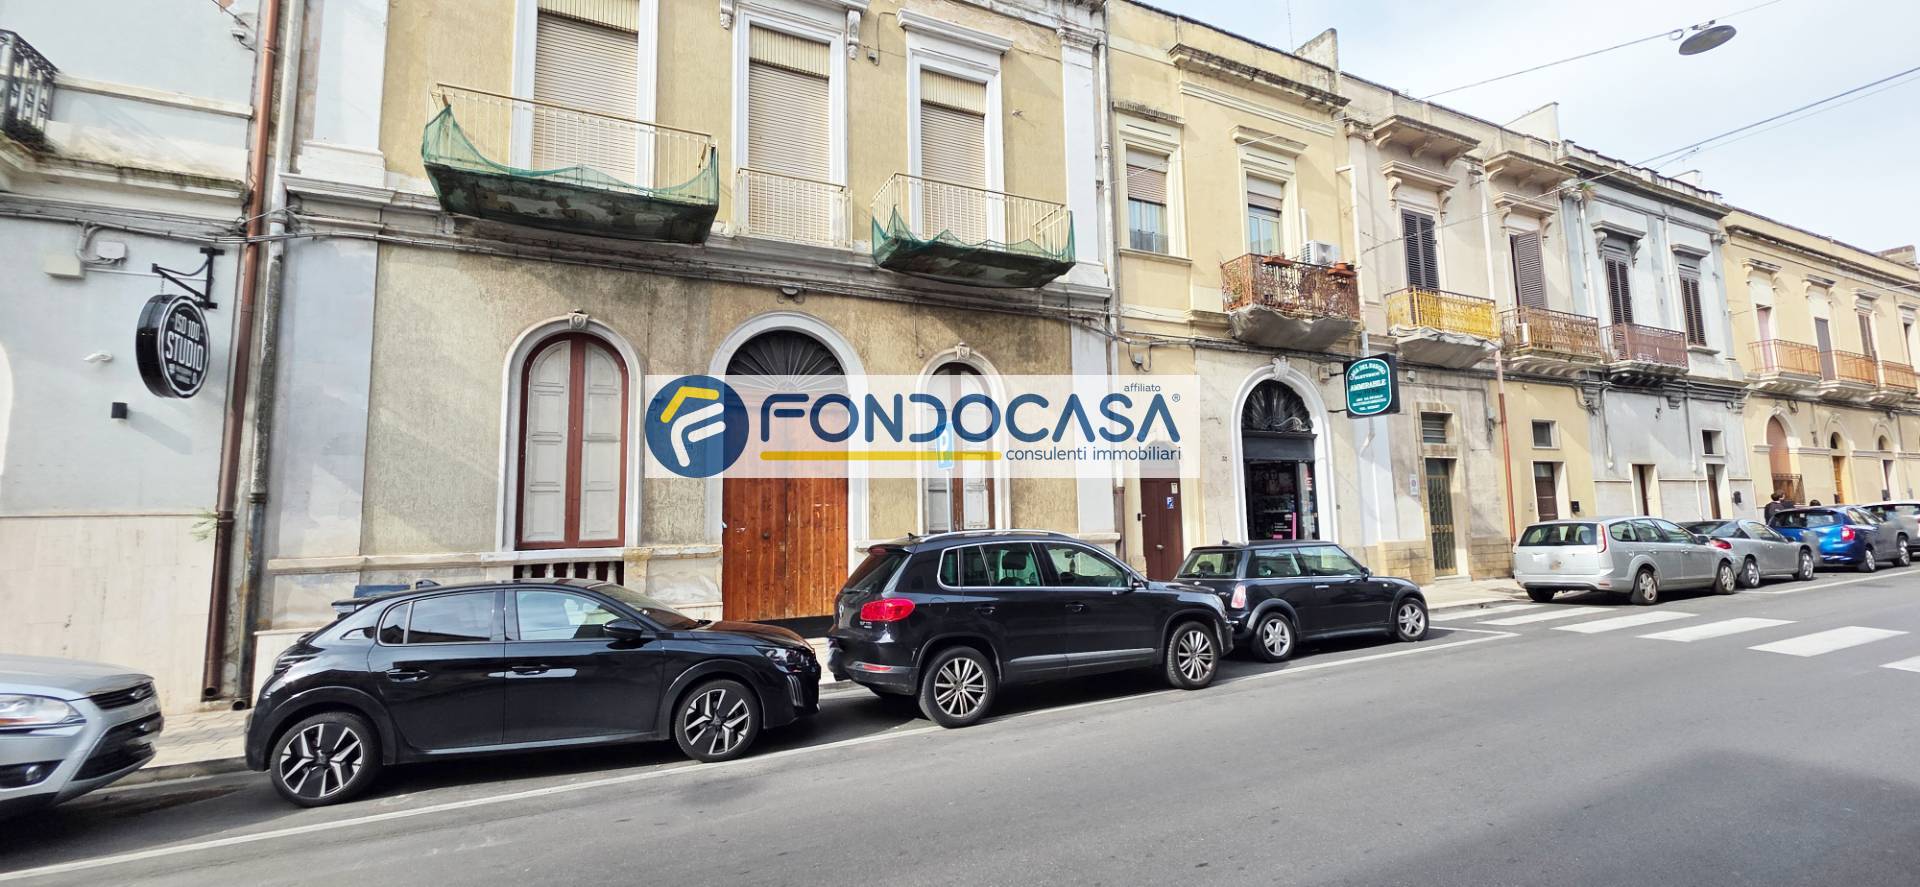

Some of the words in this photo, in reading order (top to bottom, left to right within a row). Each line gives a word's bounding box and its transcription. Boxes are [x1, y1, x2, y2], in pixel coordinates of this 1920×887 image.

[174, 312, 187, 334] ISO
[188, 320, 201, 341] 100
[165, 330, 204, 372] STUDIO
